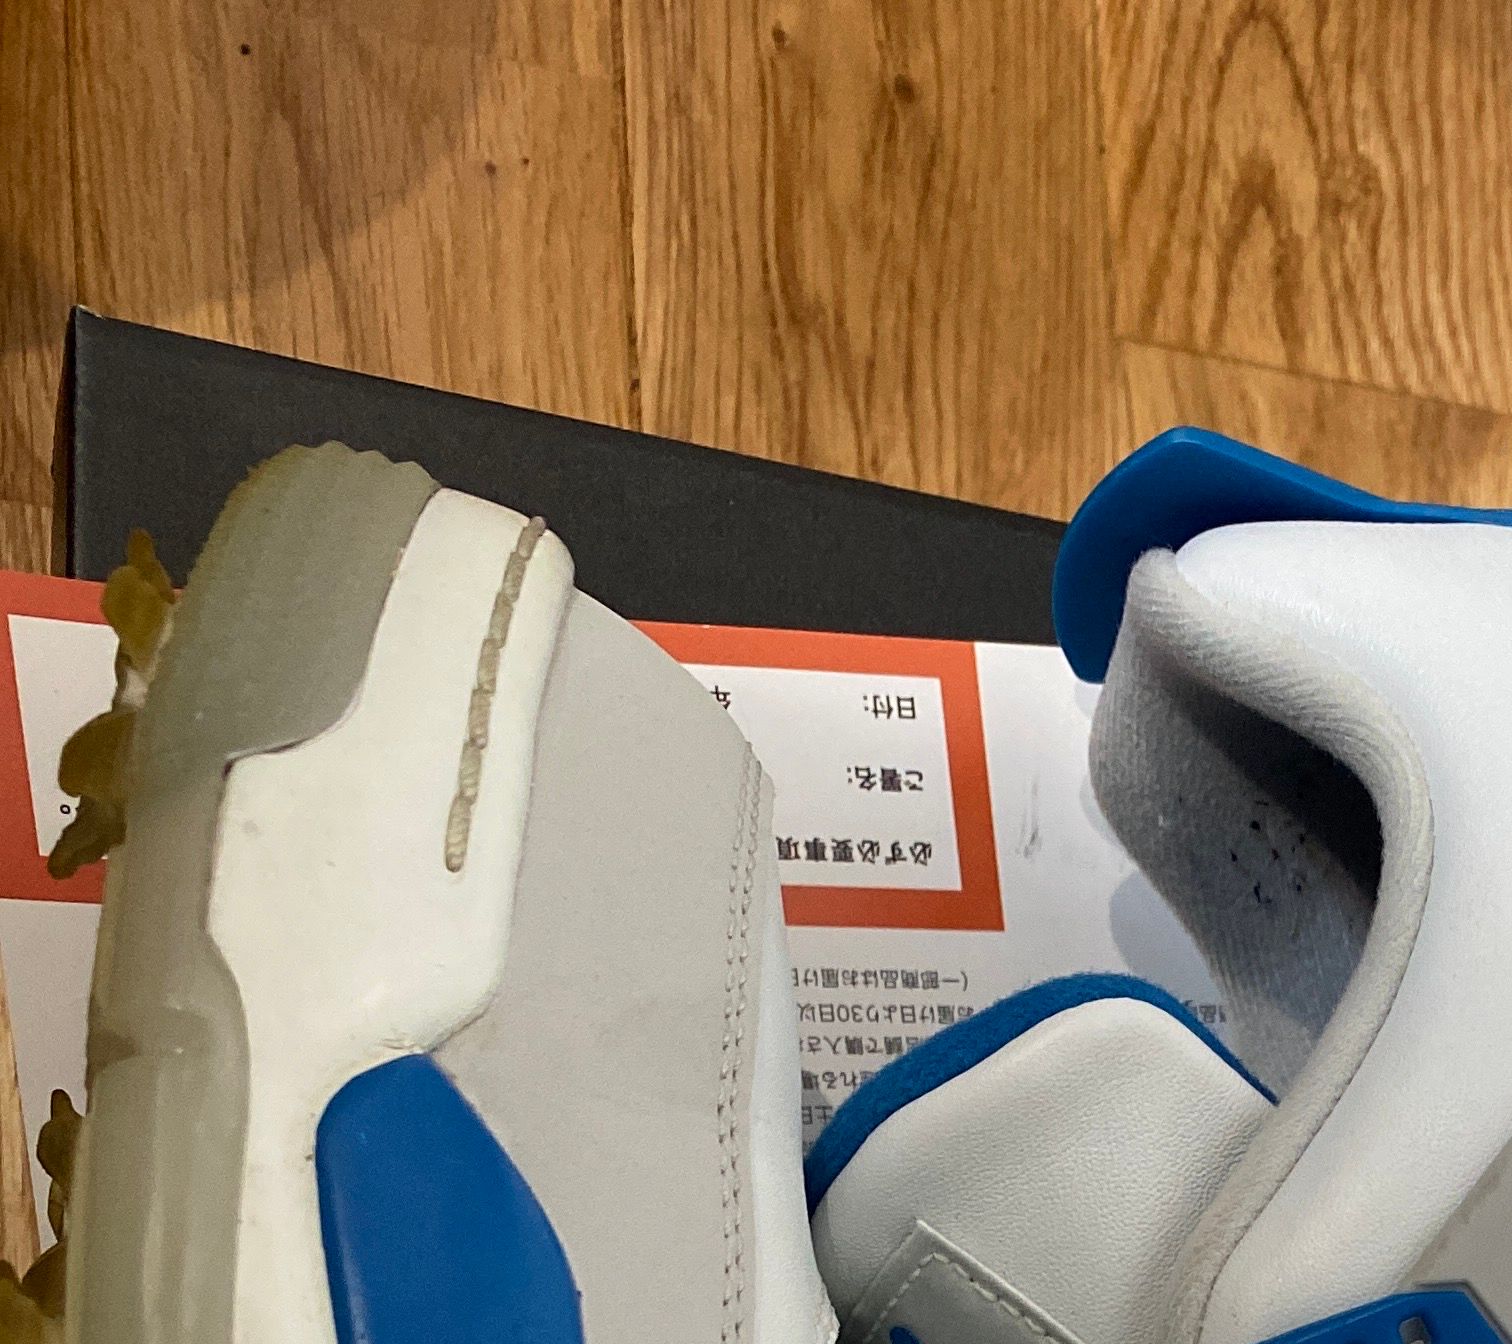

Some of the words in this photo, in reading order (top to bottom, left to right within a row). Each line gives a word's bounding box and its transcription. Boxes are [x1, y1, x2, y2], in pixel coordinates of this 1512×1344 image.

[863, 695, 916, 720] 日付:
[846, 766, 924, 792] ご署名:
[776, 837, 932, 867] 必ず必要事項
